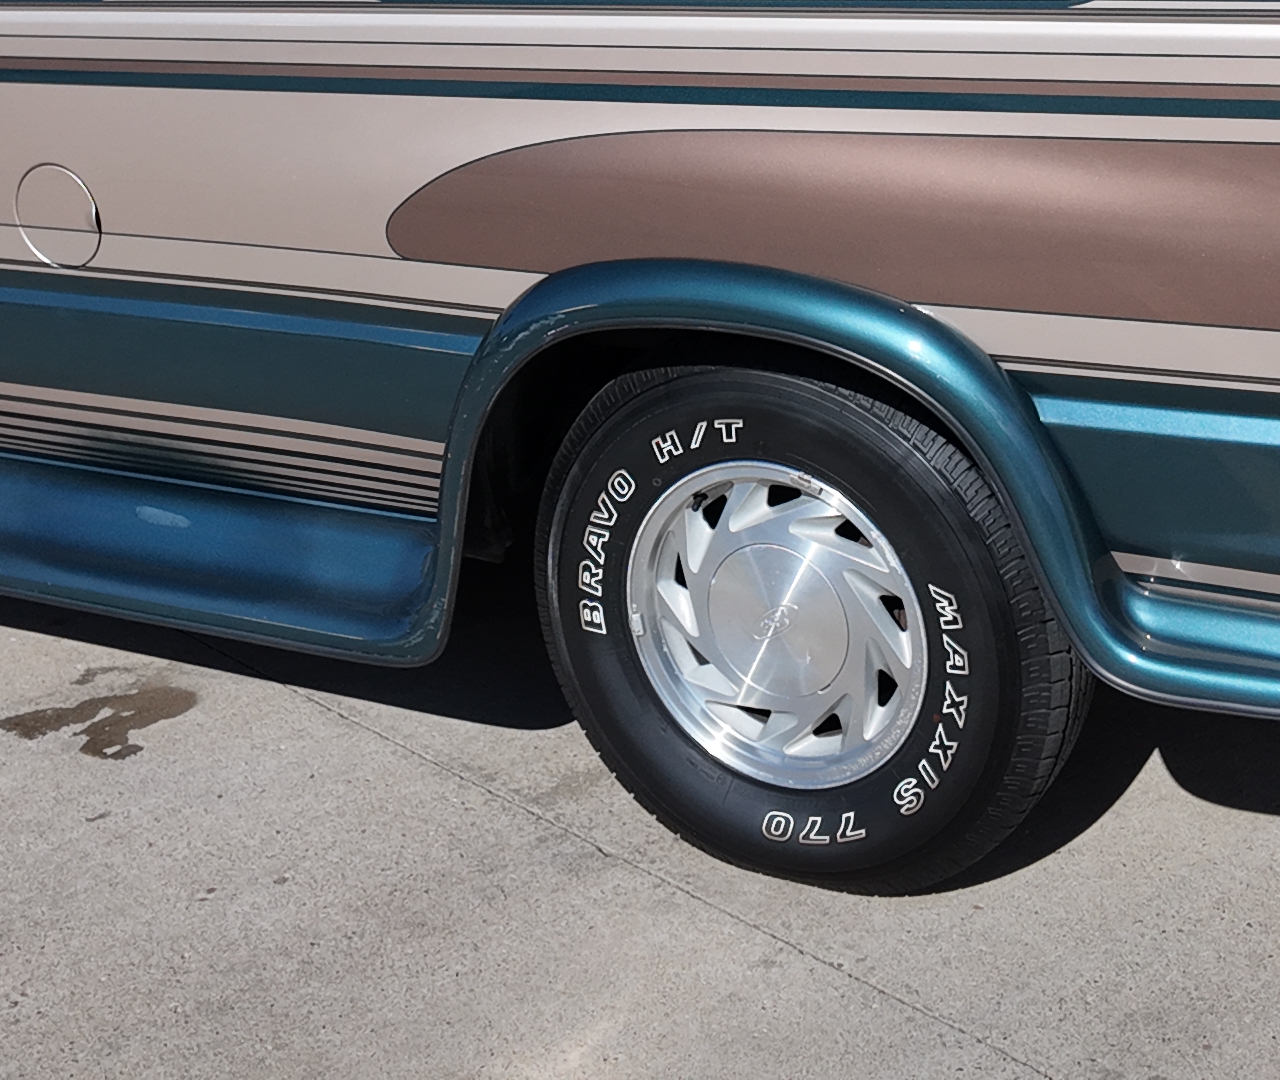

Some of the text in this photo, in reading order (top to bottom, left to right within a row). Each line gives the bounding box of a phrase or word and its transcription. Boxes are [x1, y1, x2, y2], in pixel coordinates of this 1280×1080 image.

[578, 418, 744, 634] BRAVO H/T
[893, 584, 970, 816] MAXXIS
[762, 811, 867, 844] 770
